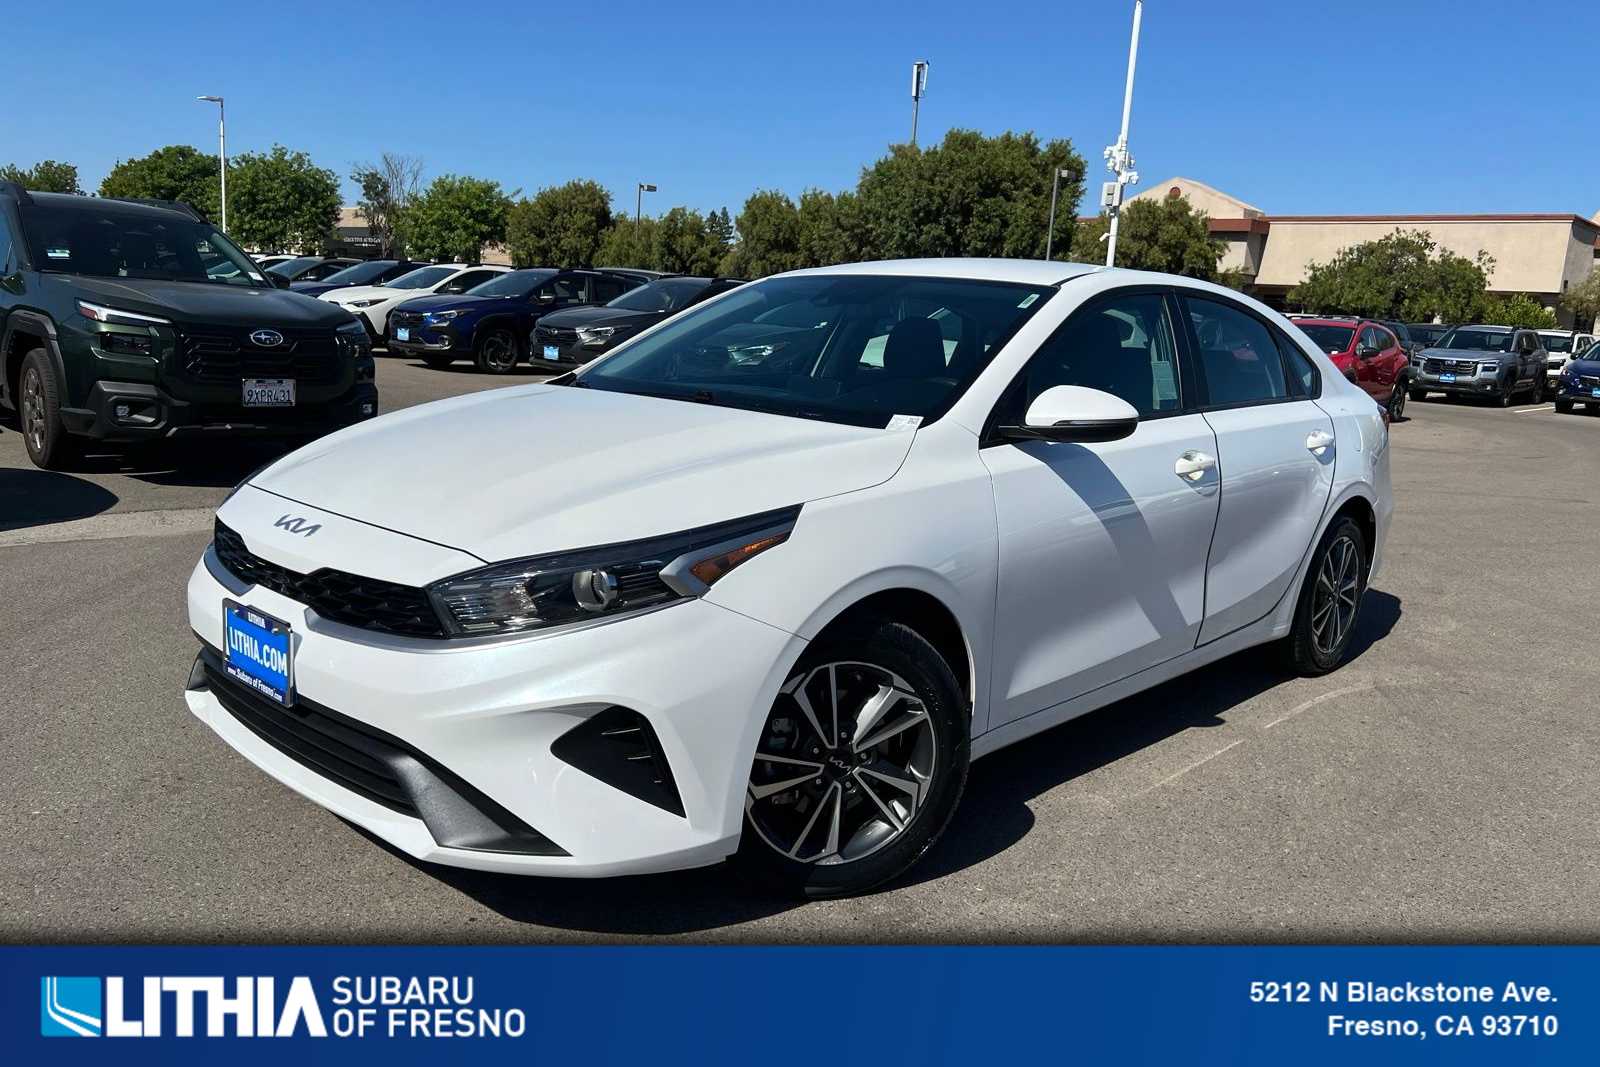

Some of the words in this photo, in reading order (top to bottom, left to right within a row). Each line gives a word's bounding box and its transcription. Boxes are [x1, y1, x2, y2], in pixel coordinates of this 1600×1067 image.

[247, 389, 291, 403] 9XPR431
[273, 513, 322, 538] KIA
[247, 612, 266, 629] LITHIA
[229, 626, 288, 678] LITHIA.COM
